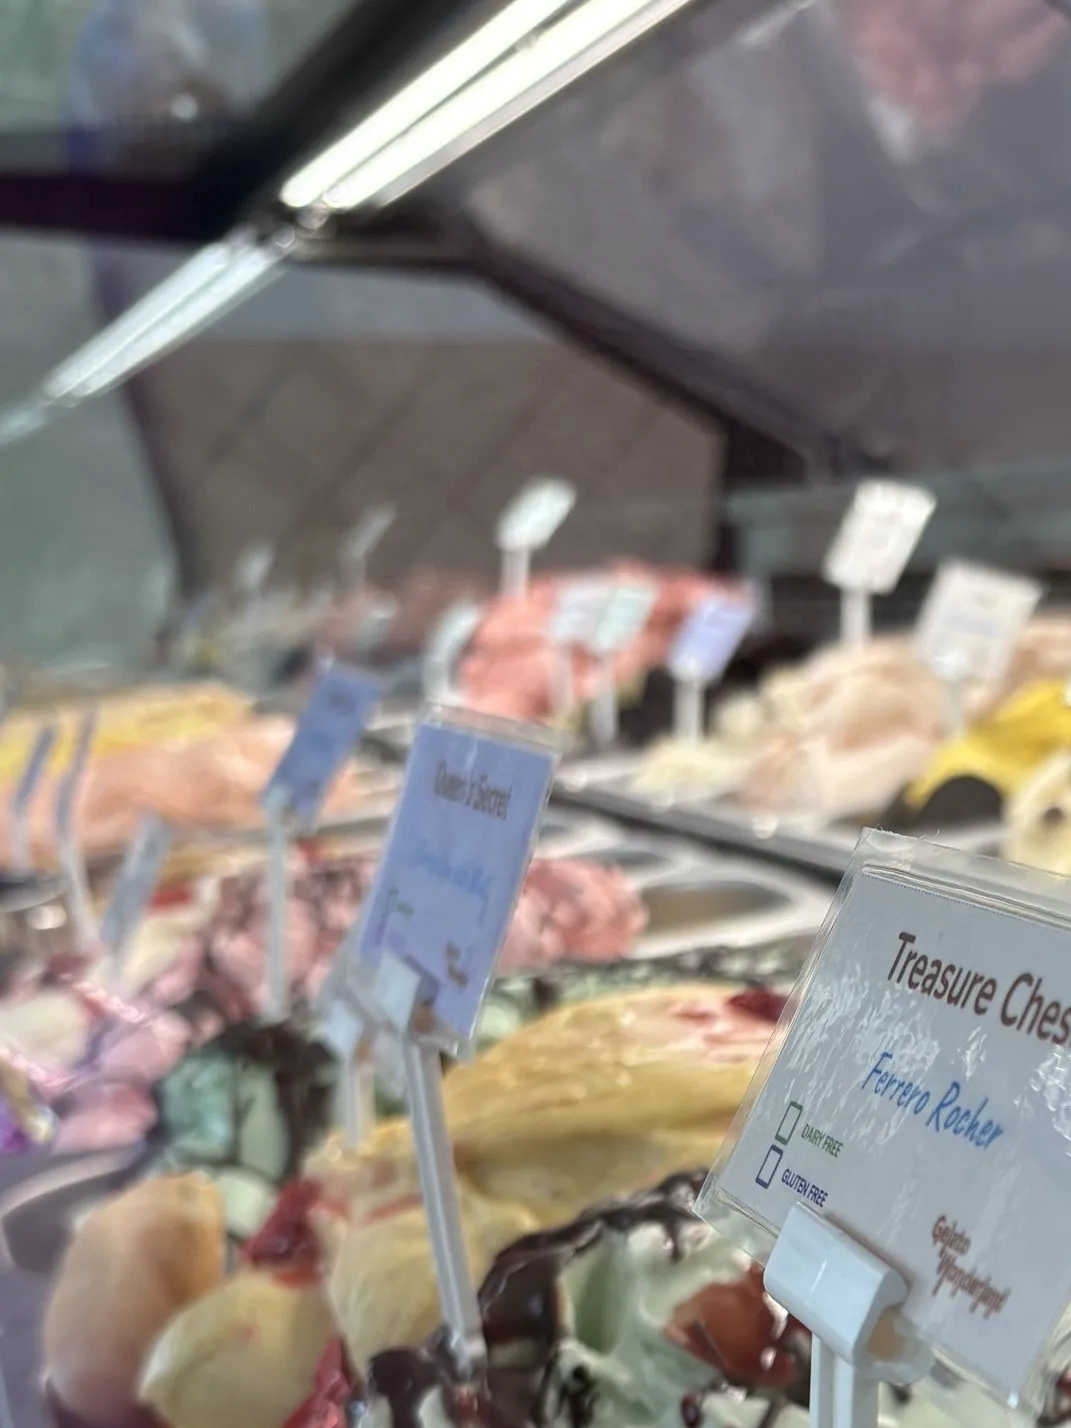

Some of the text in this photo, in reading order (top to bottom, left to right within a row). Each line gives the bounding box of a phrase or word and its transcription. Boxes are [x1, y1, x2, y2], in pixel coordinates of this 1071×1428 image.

[887, 931, 998, 1015] Treasure
[861, 1051, 1005, 1149] Ferrero Rocher
[801, 1123, 844, 1158] DAIRY FREE
[781, 1168, 829, 1208] GLUTEN FREE
[932, 1214, 972, 1258] Gelato
